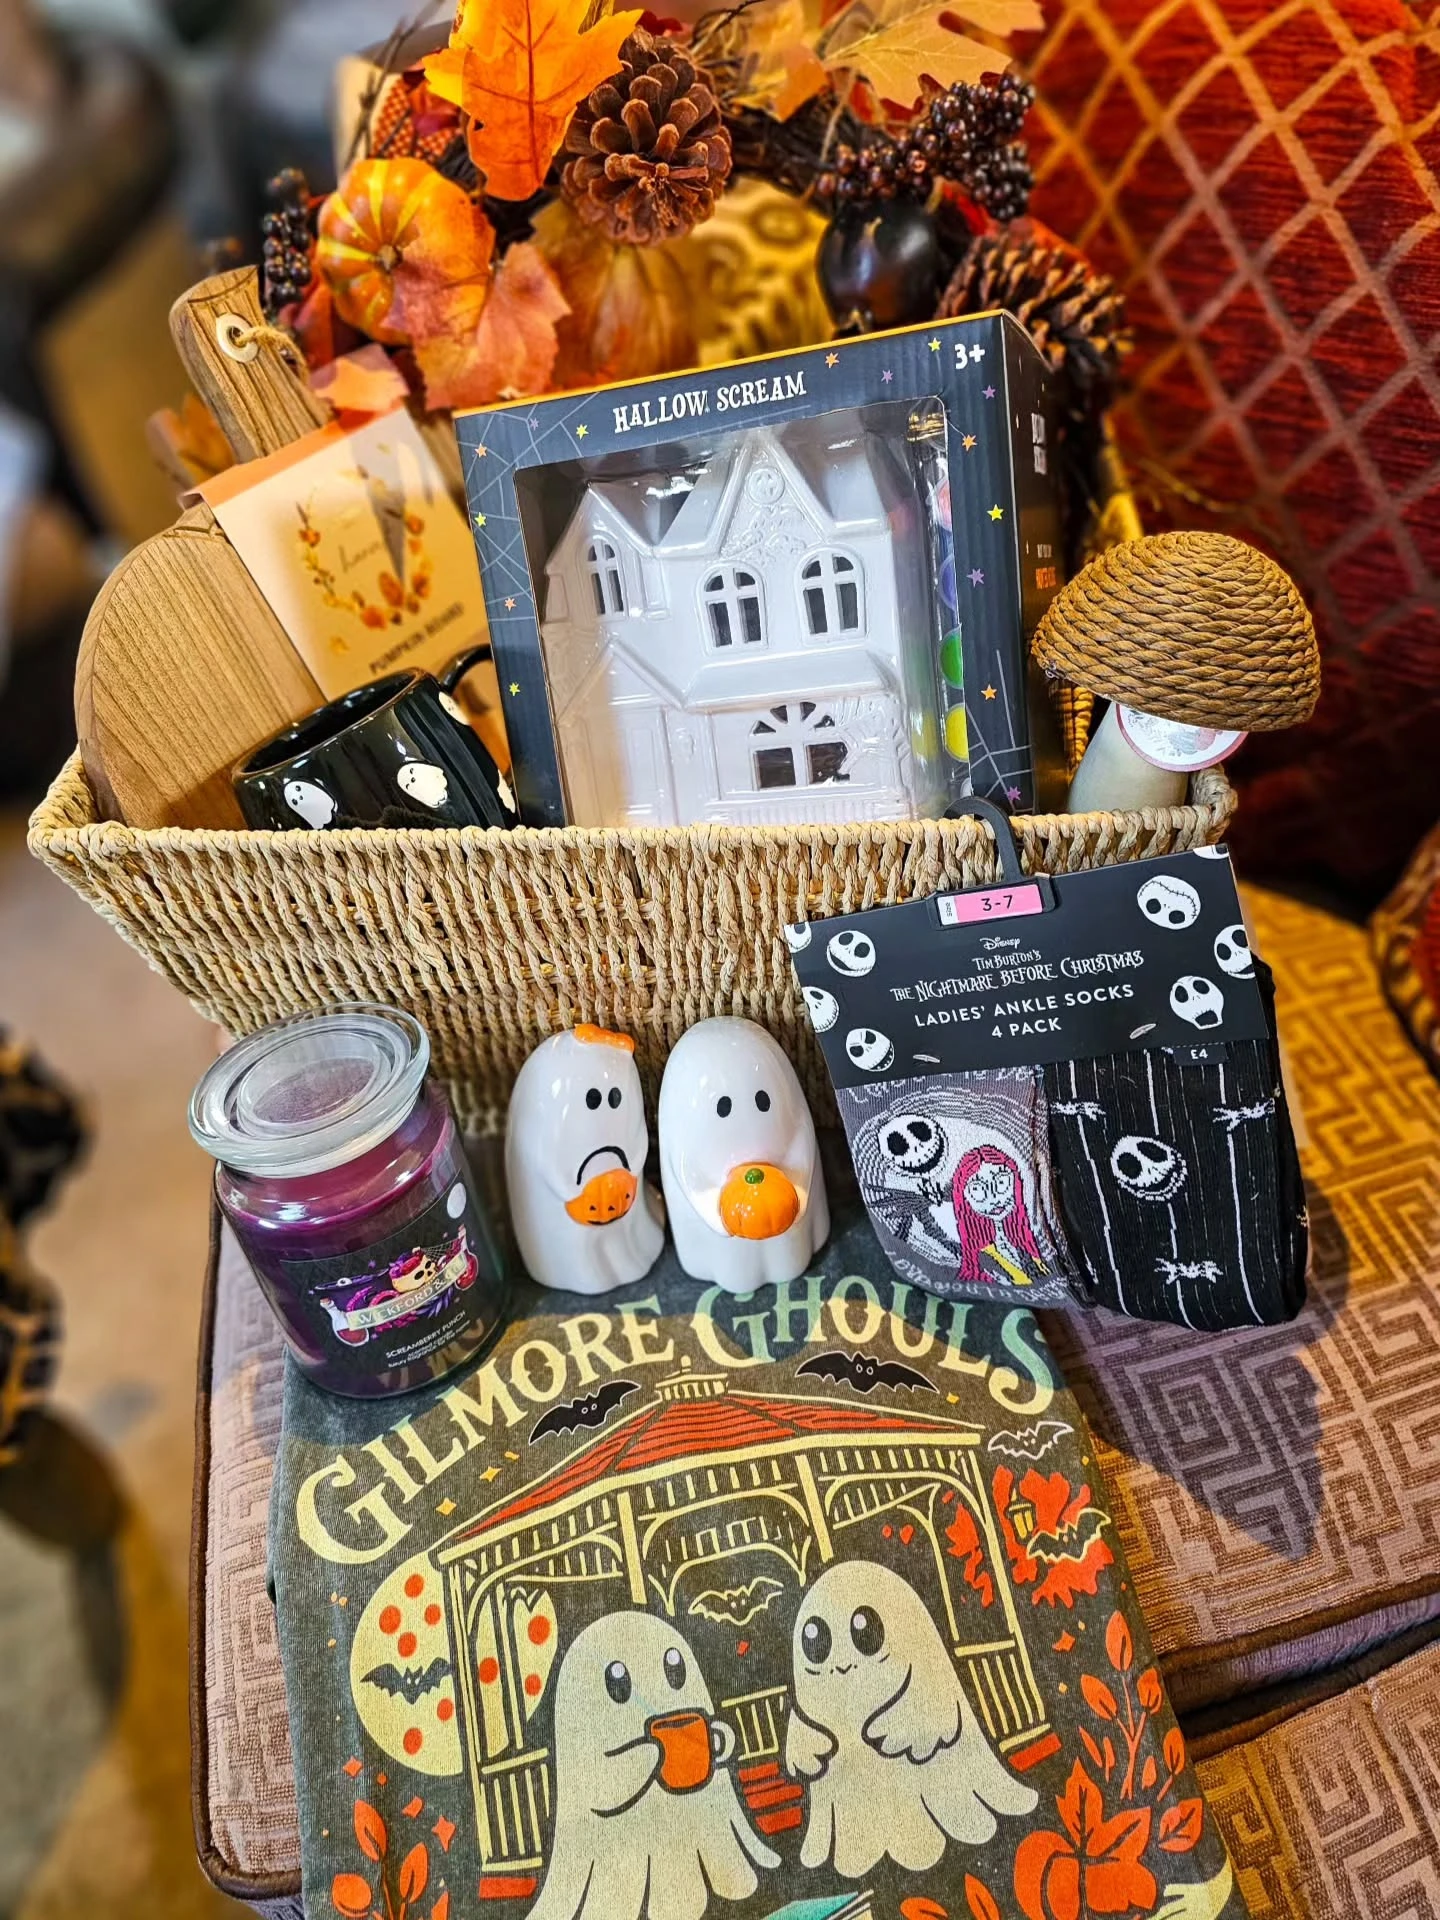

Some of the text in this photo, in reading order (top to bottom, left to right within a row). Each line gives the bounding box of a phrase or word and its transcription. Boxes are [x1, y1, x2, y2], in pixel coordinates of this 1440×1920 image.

[953, 342, 986, 370] 3+
[613, 371, 807, 434] HALLOW SCREAM
[981, 894, 1014, 912] 3-7
[890, 950, 1145, 1003] THE NIGHTMARE BEFORE CHRISTMAS
[914, 984, 1135, 1028] LADIES' ANKLE SOCKS
[991, 1017, 1062, 1039] 4 PACK
[1190, 1048, 1209, 1060] £4
[385, 1310, 466, 1359] SCREAMBERRY PUNCH
[296, 1273, 1054, 1564] GILMORE GHOULS
